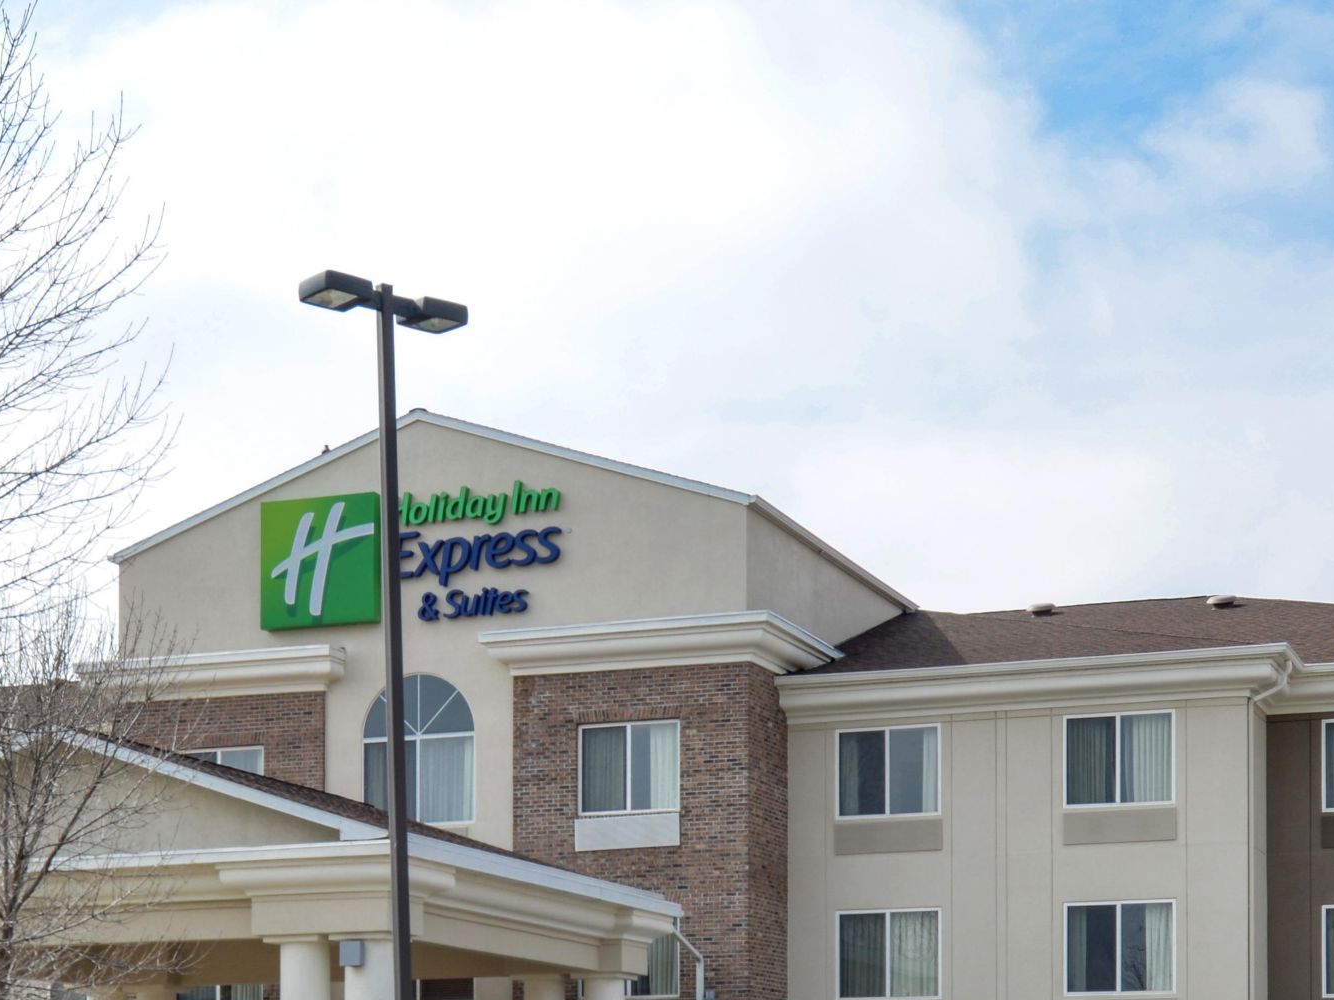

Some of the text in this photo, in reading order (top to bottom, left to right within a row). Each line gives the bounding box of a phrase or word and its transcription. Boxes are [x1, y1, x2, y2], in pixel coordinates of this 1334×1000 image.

[510, 480, 562, 514] Inn
[398, 526, 562, 588] Express
[417, 587, 530, 622] & Suites
